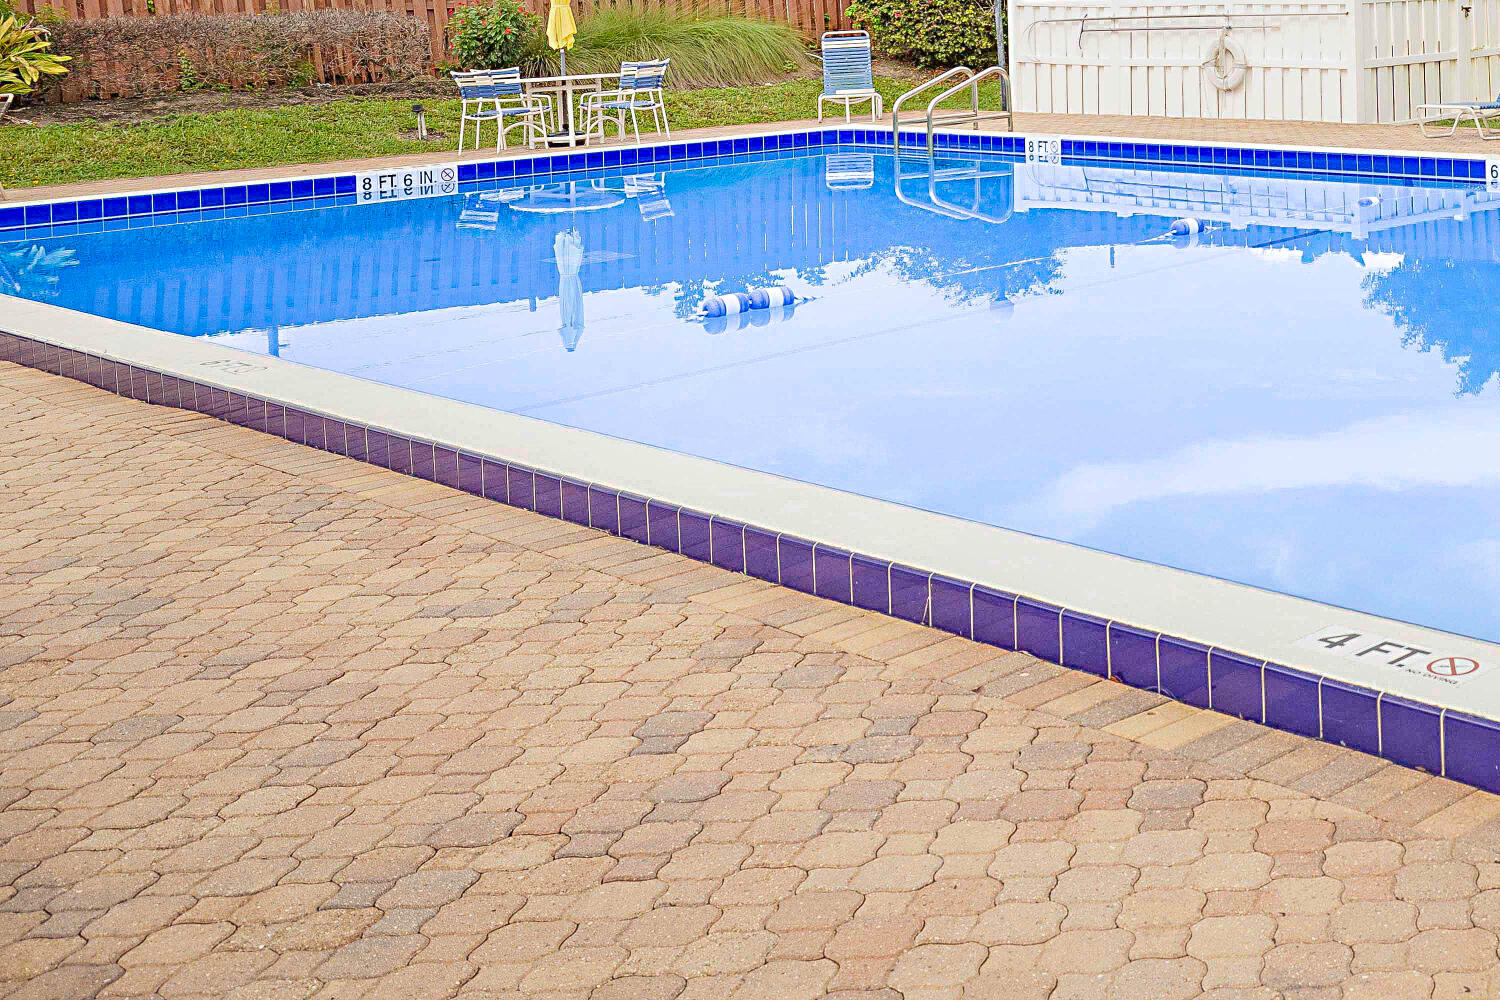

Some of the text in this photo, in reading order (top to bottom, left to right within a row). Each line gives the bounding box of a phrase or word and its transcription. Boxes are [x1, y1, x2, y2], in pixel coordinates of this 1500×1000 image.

[1028, 141, 1034, 153] 8
[362, 170, 437, 191] 8 FT. 6 IN.
[1490, 164, 1499, 179] 6
[1317, 633, 1432, 668] 4 FT.
